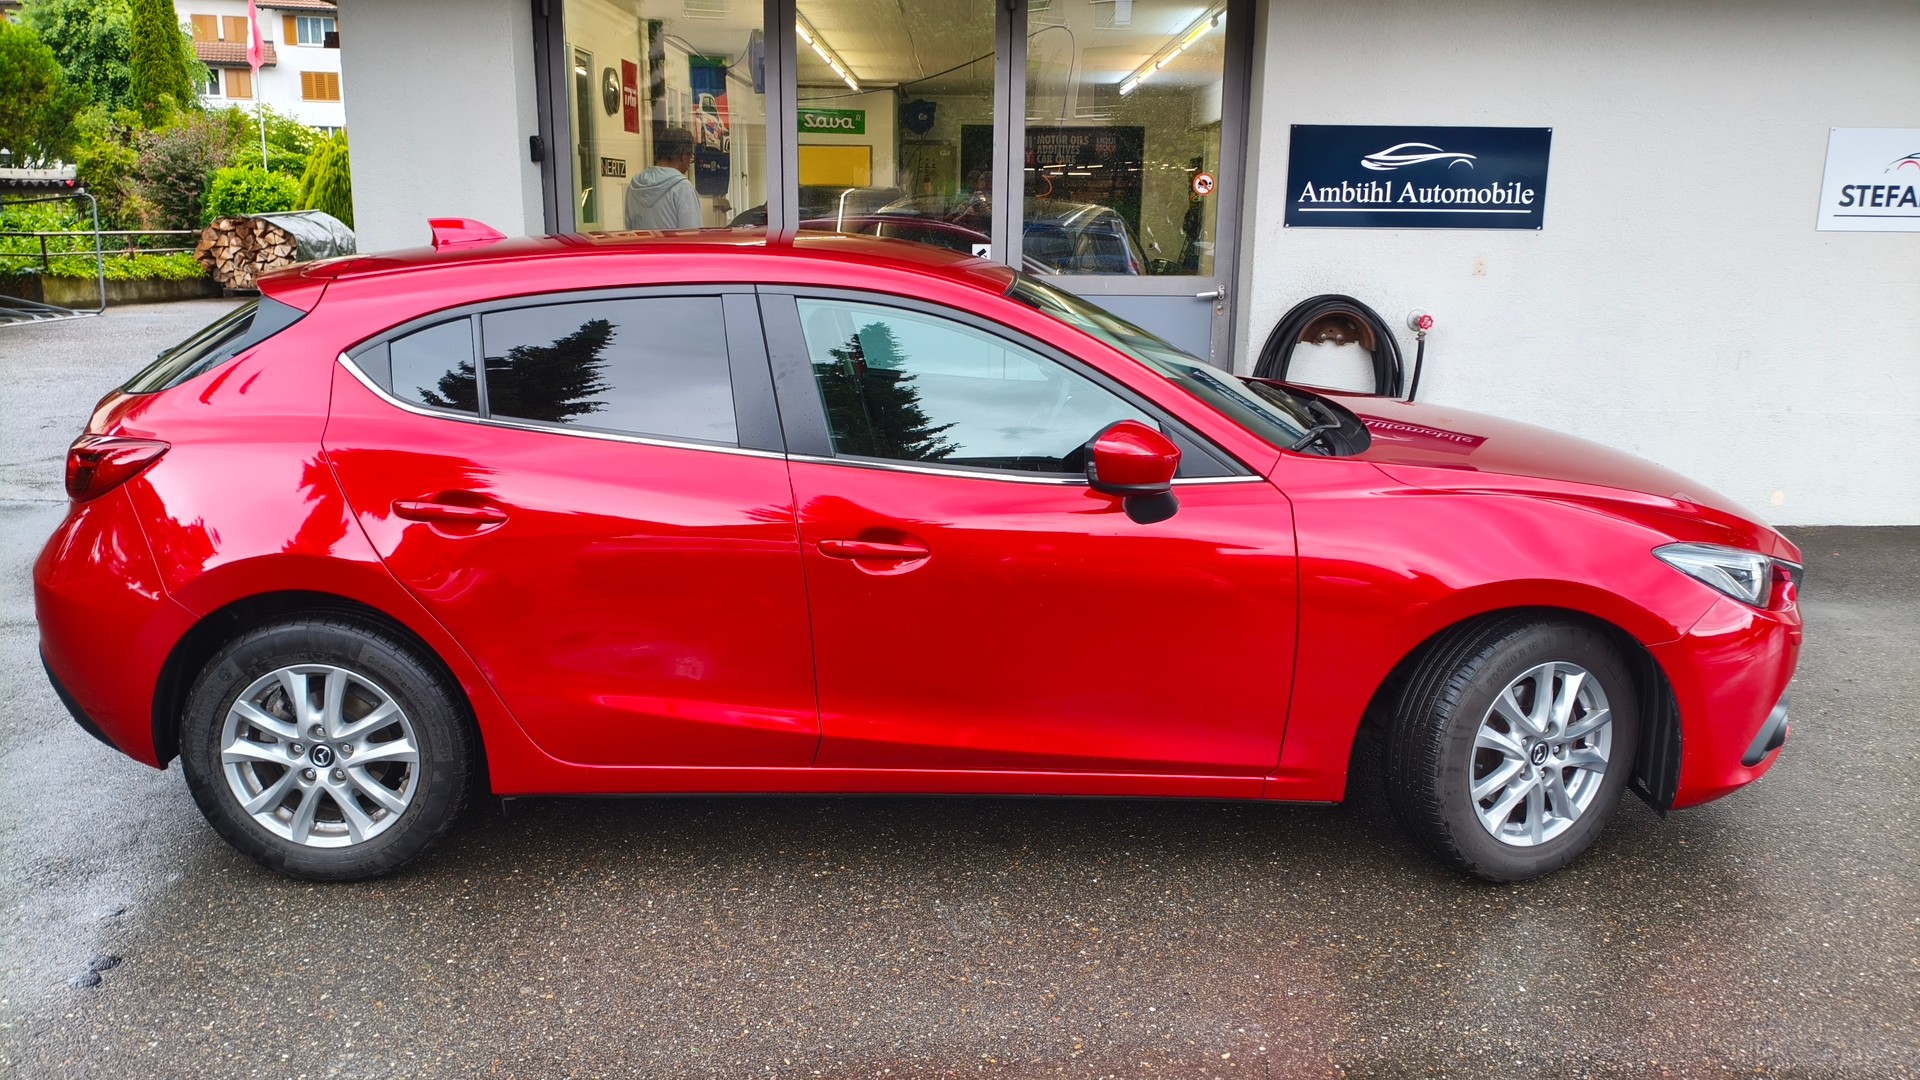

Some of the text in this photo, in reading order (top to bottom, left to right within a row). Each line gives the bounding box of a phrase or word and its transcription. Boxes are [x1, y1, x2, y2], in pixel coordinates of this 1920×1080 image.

[804, 113, 855, 129] Sava
[1036, 134, 1068, 145] MOTOR
[1070, 135, 1090, 146] OILS
[1036, 144, 1080, 154] ADDITIVES
[1036, 154, 1053, 164] CAR
[1298, 180, 1535, 205] Ambühl Automobile
[1838, 184, 1920, 207] STEFA
